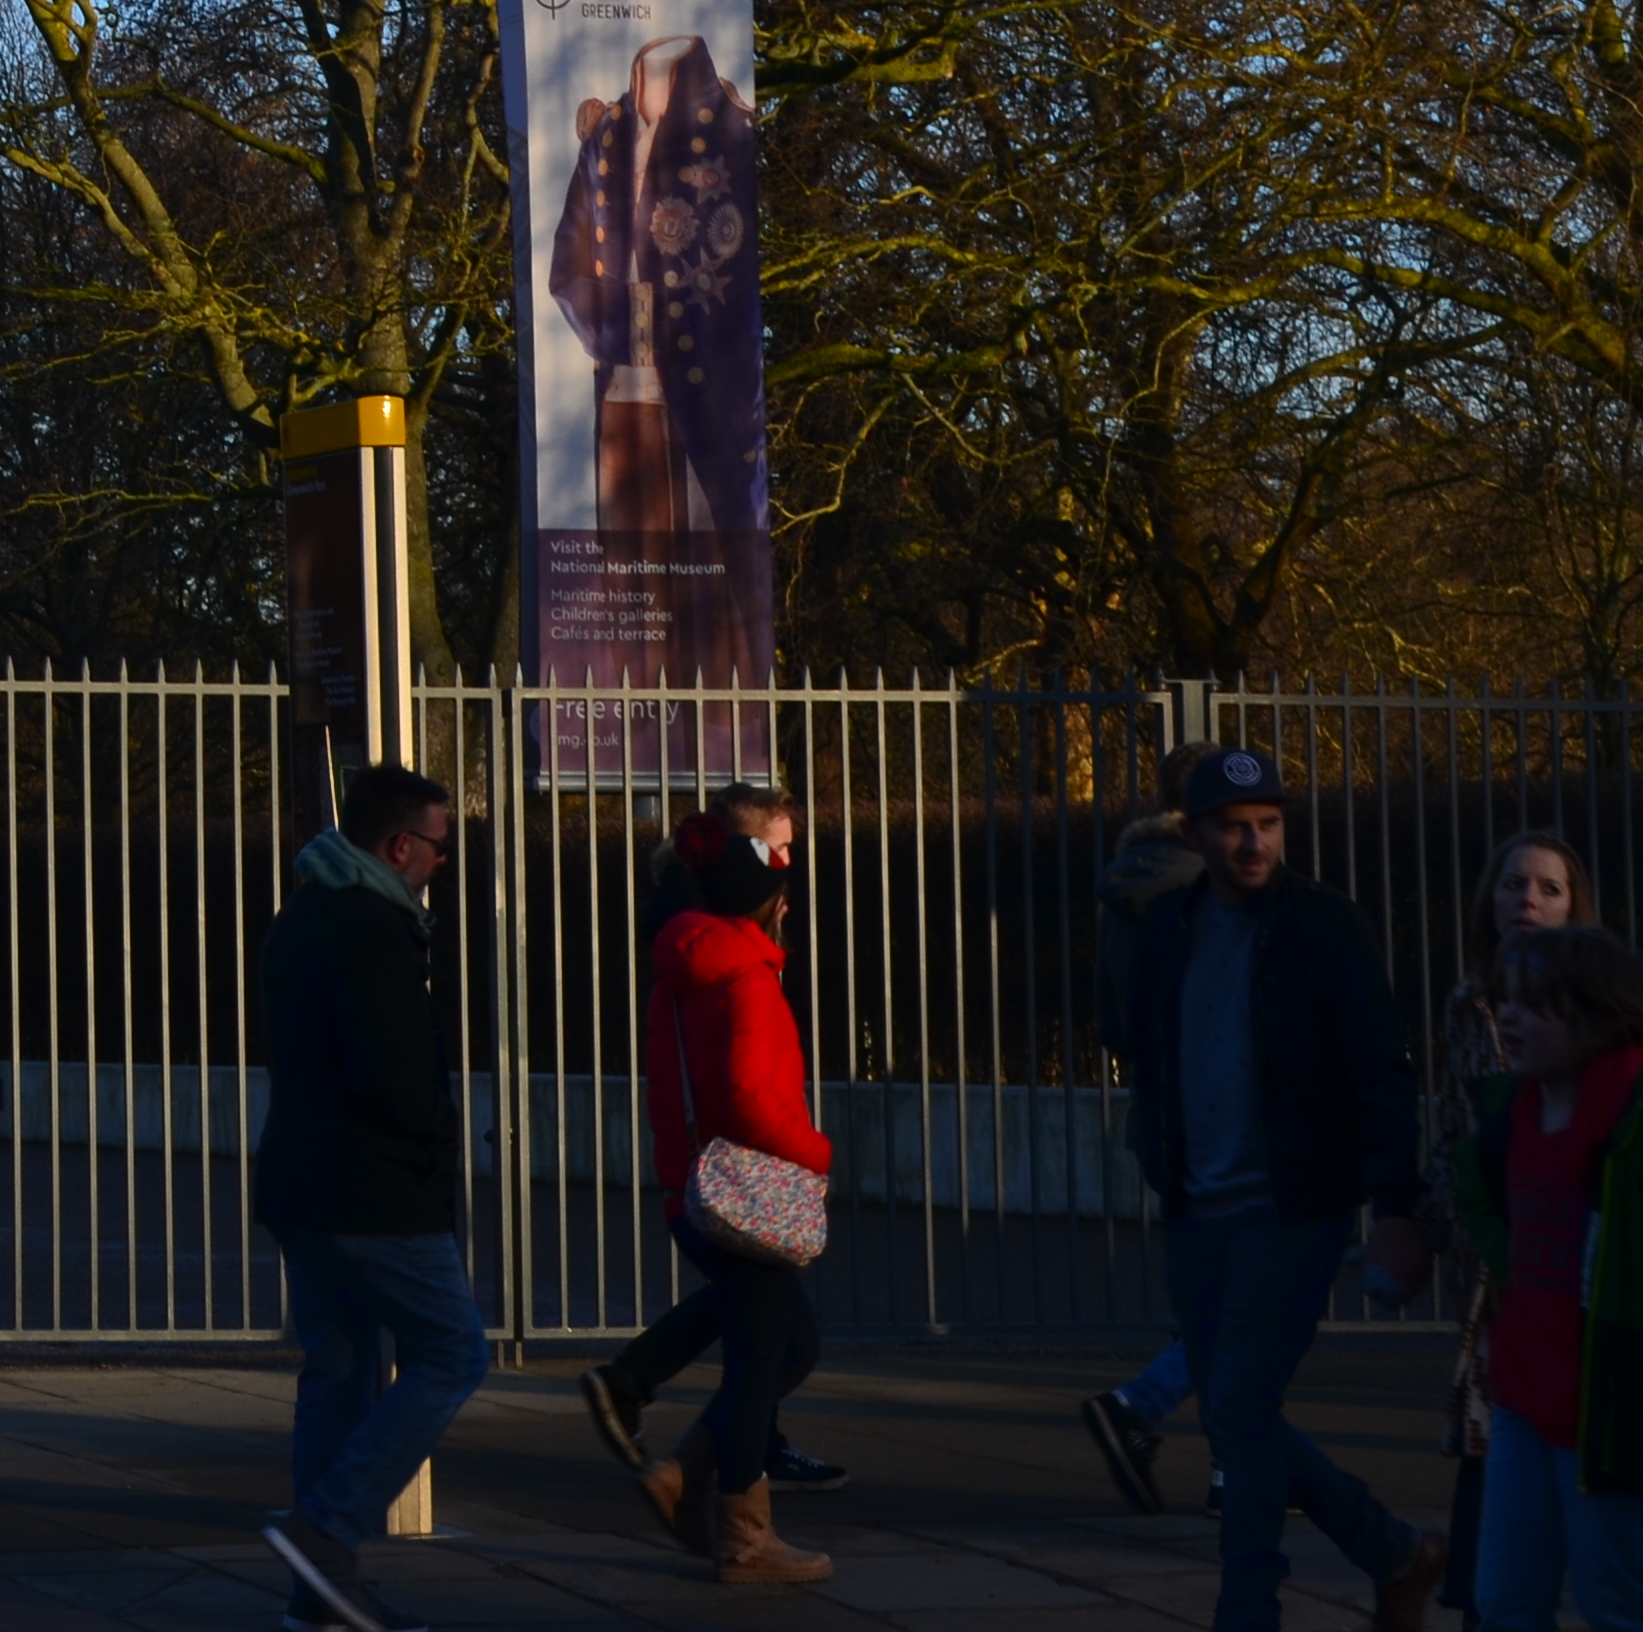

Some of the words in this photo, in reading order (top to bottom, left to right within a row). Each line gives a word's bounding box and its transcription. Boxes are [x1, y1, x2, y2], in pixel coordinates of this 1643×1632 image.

[581, 3, 652, 20] GREENWICH
[550, 539, 583, 555] Visit
[585, 540, 605, 556] the
[550, 559, 606, 575] National
[607, 559, 667, 576] Maritime
[668, 561, 727, 576] Museum
[550, 588, 606, 603] Maritime
[609, 588, 657, 606] history
[550, 606, 615, 622] Children's
[618, 607, 674, 625] galleries
[550, 625, 590, 642] Cafés
[592, 627, 615, 642] and
[618, 628, 667, 642] terrace
[613, 699, 679, 725] enty
